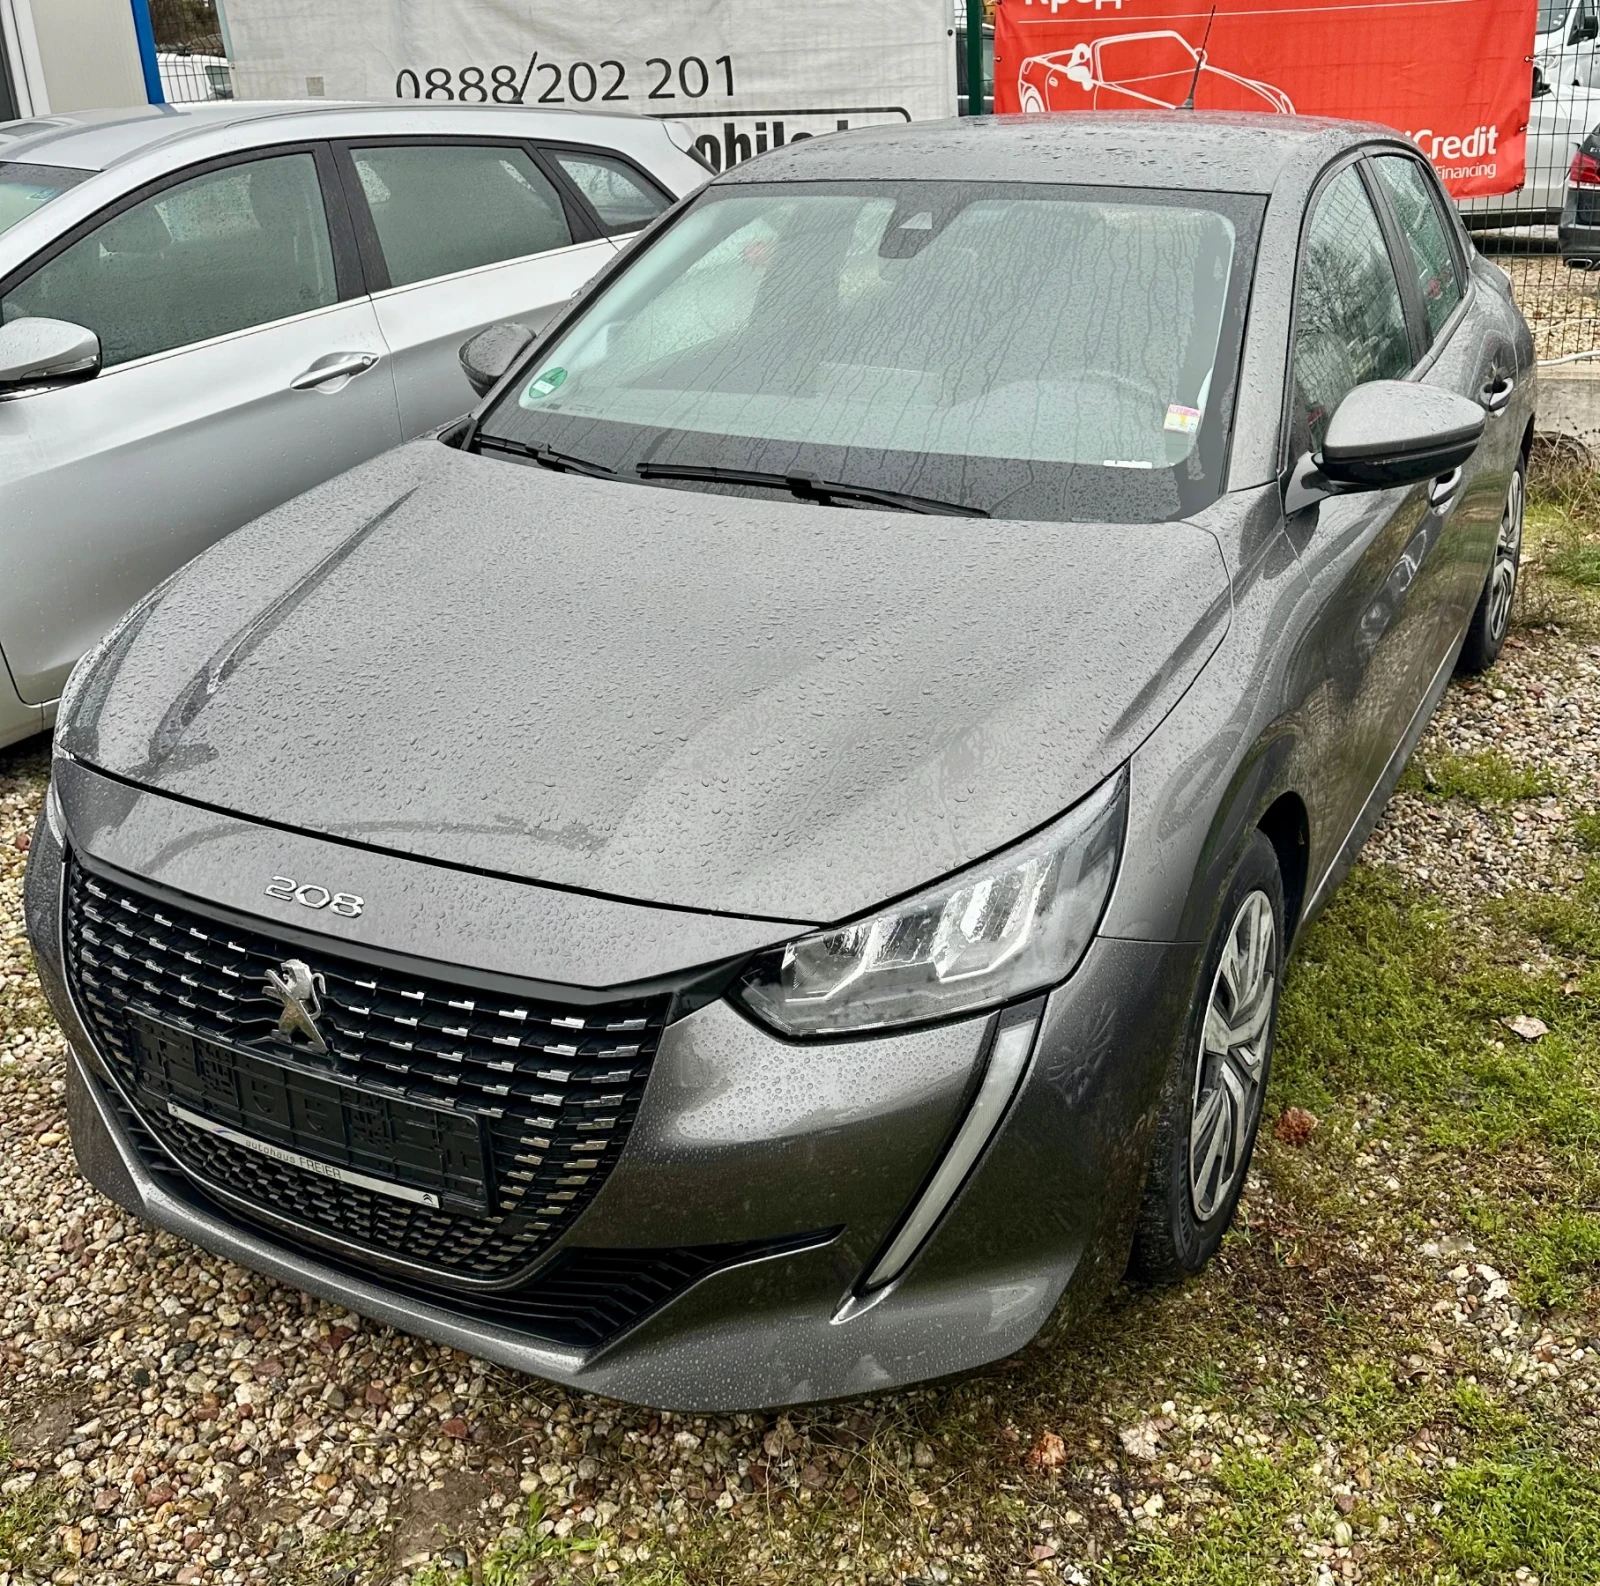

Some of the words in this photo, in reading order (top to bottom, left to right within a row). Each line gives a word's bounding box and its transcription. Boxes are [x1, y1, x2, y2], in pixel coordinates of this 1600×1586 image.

[536, 61, 629, 103] 202
[645, 55, 734, 98] 201
[1405, 125, 1498, 160] Credit
[264, 875, 365, 919] 208
[245, 1139, 297, 1164] autohaus
[299, 1156, 342, 1180] FREIER
